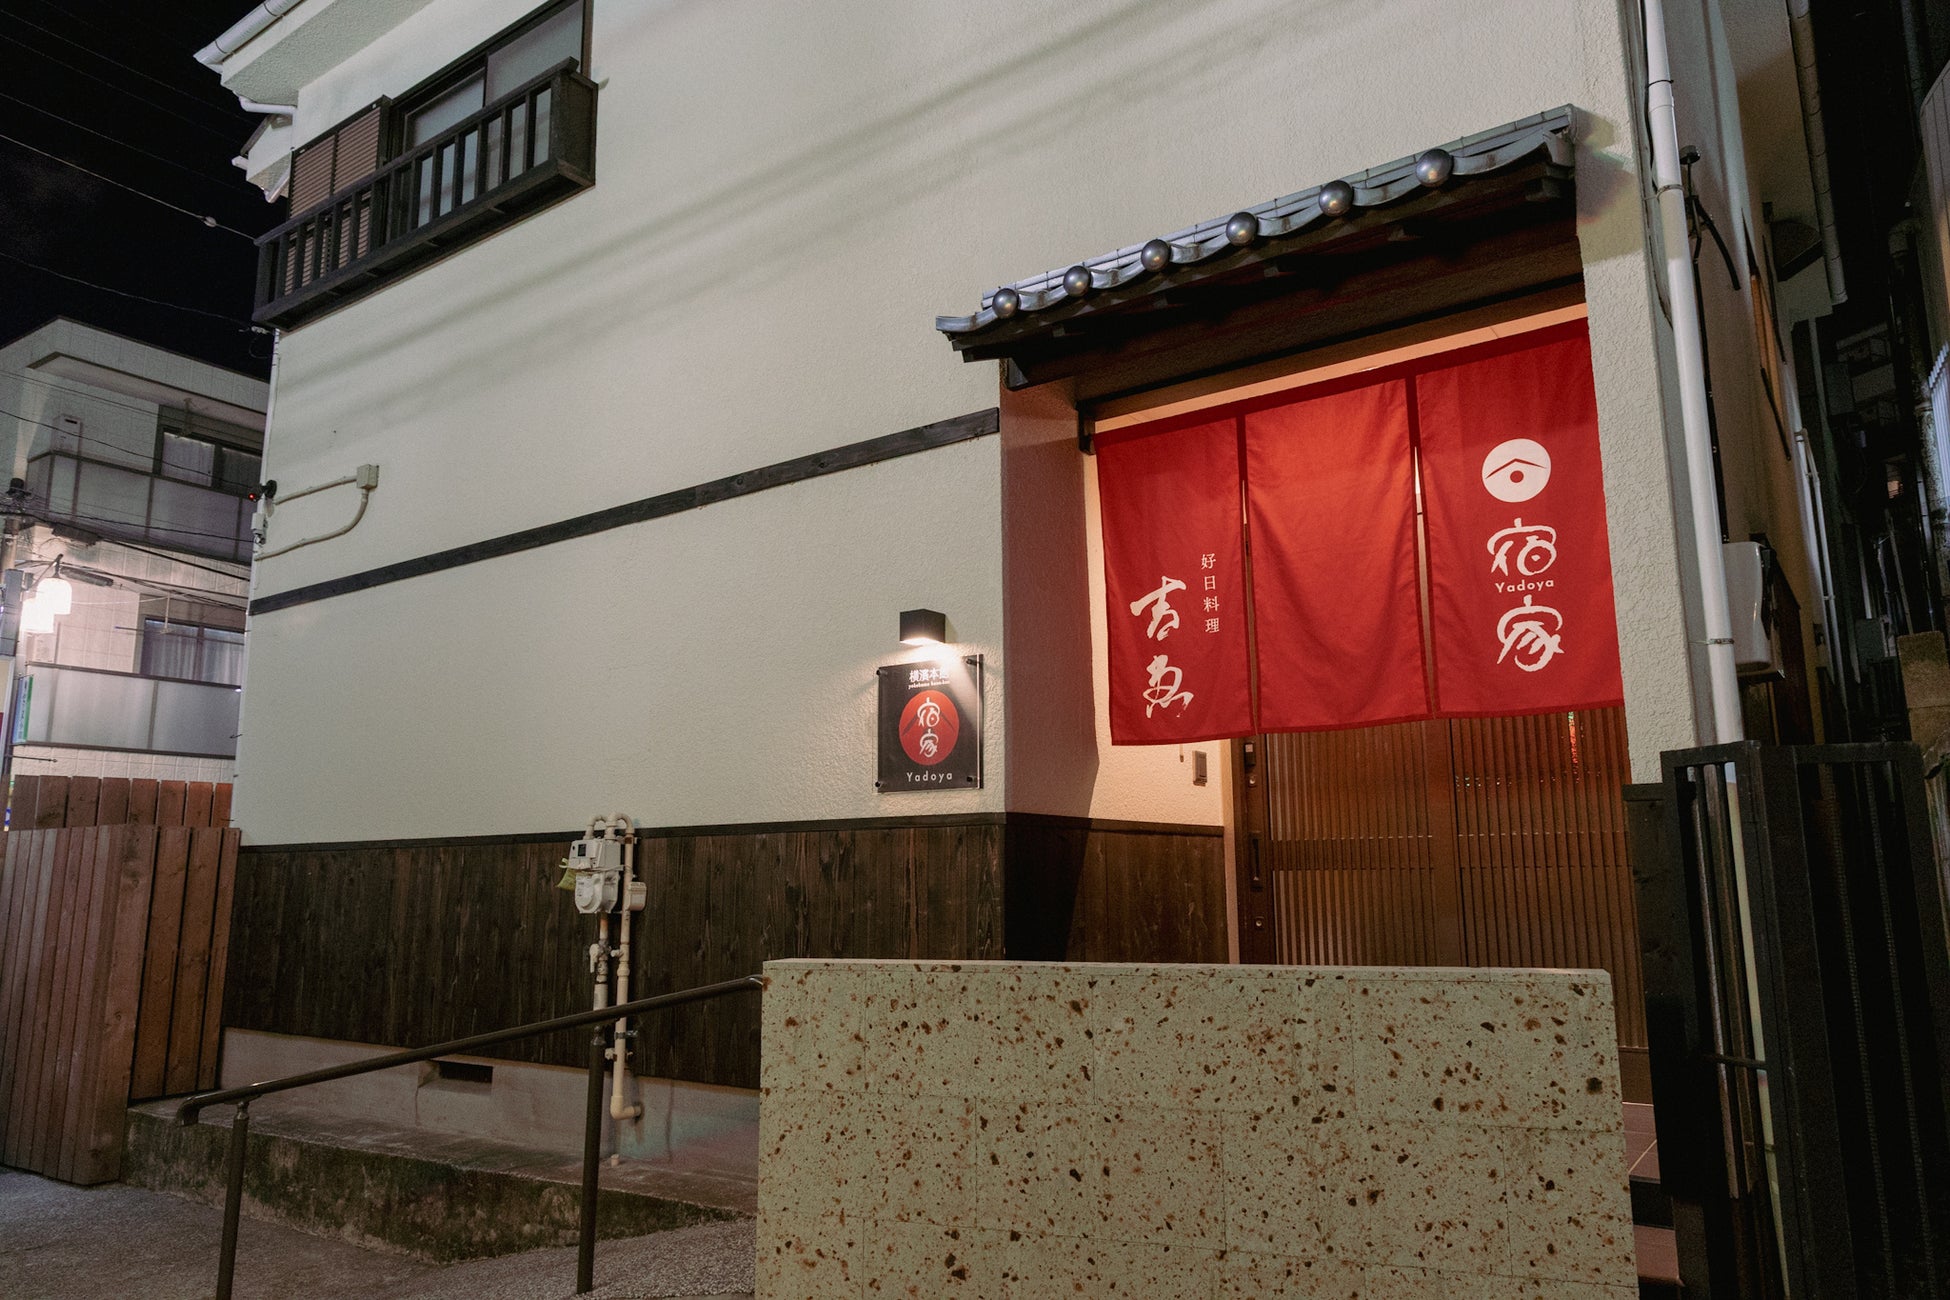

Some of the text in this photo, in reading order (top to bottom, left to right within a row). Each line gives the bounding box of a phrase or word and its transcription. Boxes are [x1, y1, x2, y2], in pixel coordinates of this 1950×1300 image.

[1201, 553, 1220, 633] 好日料理
[1495, 579, 1554, 593] Yadoya
[907, 771, 953, 783] Yadoya
